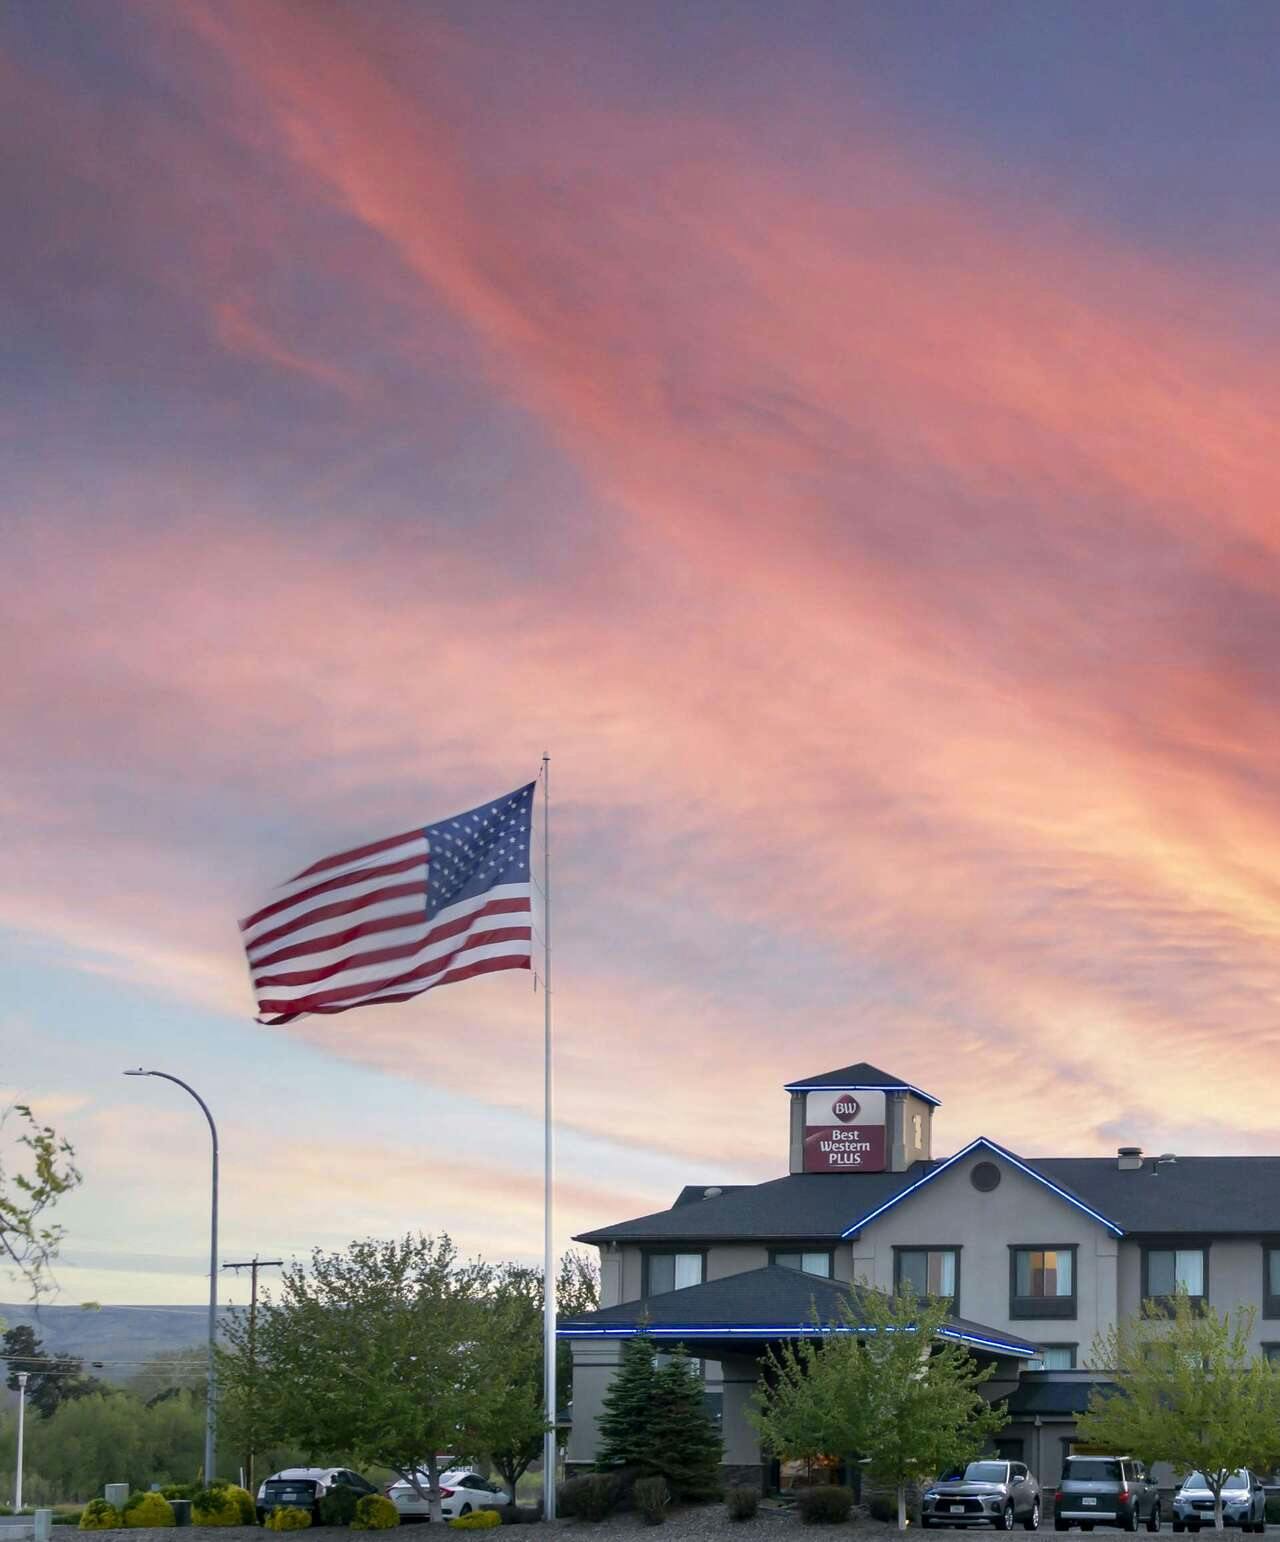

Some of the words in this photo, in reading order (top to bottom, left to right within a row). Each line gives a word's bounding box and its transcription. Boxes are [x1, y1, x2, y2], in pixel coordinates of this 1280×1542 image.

[835, 1103, 857, 1114] BW
[832, 1130, 859, 1140] Best
[820, 1141, 870, 1152] Western
[829, 1153, 861, 1164] PLUS
